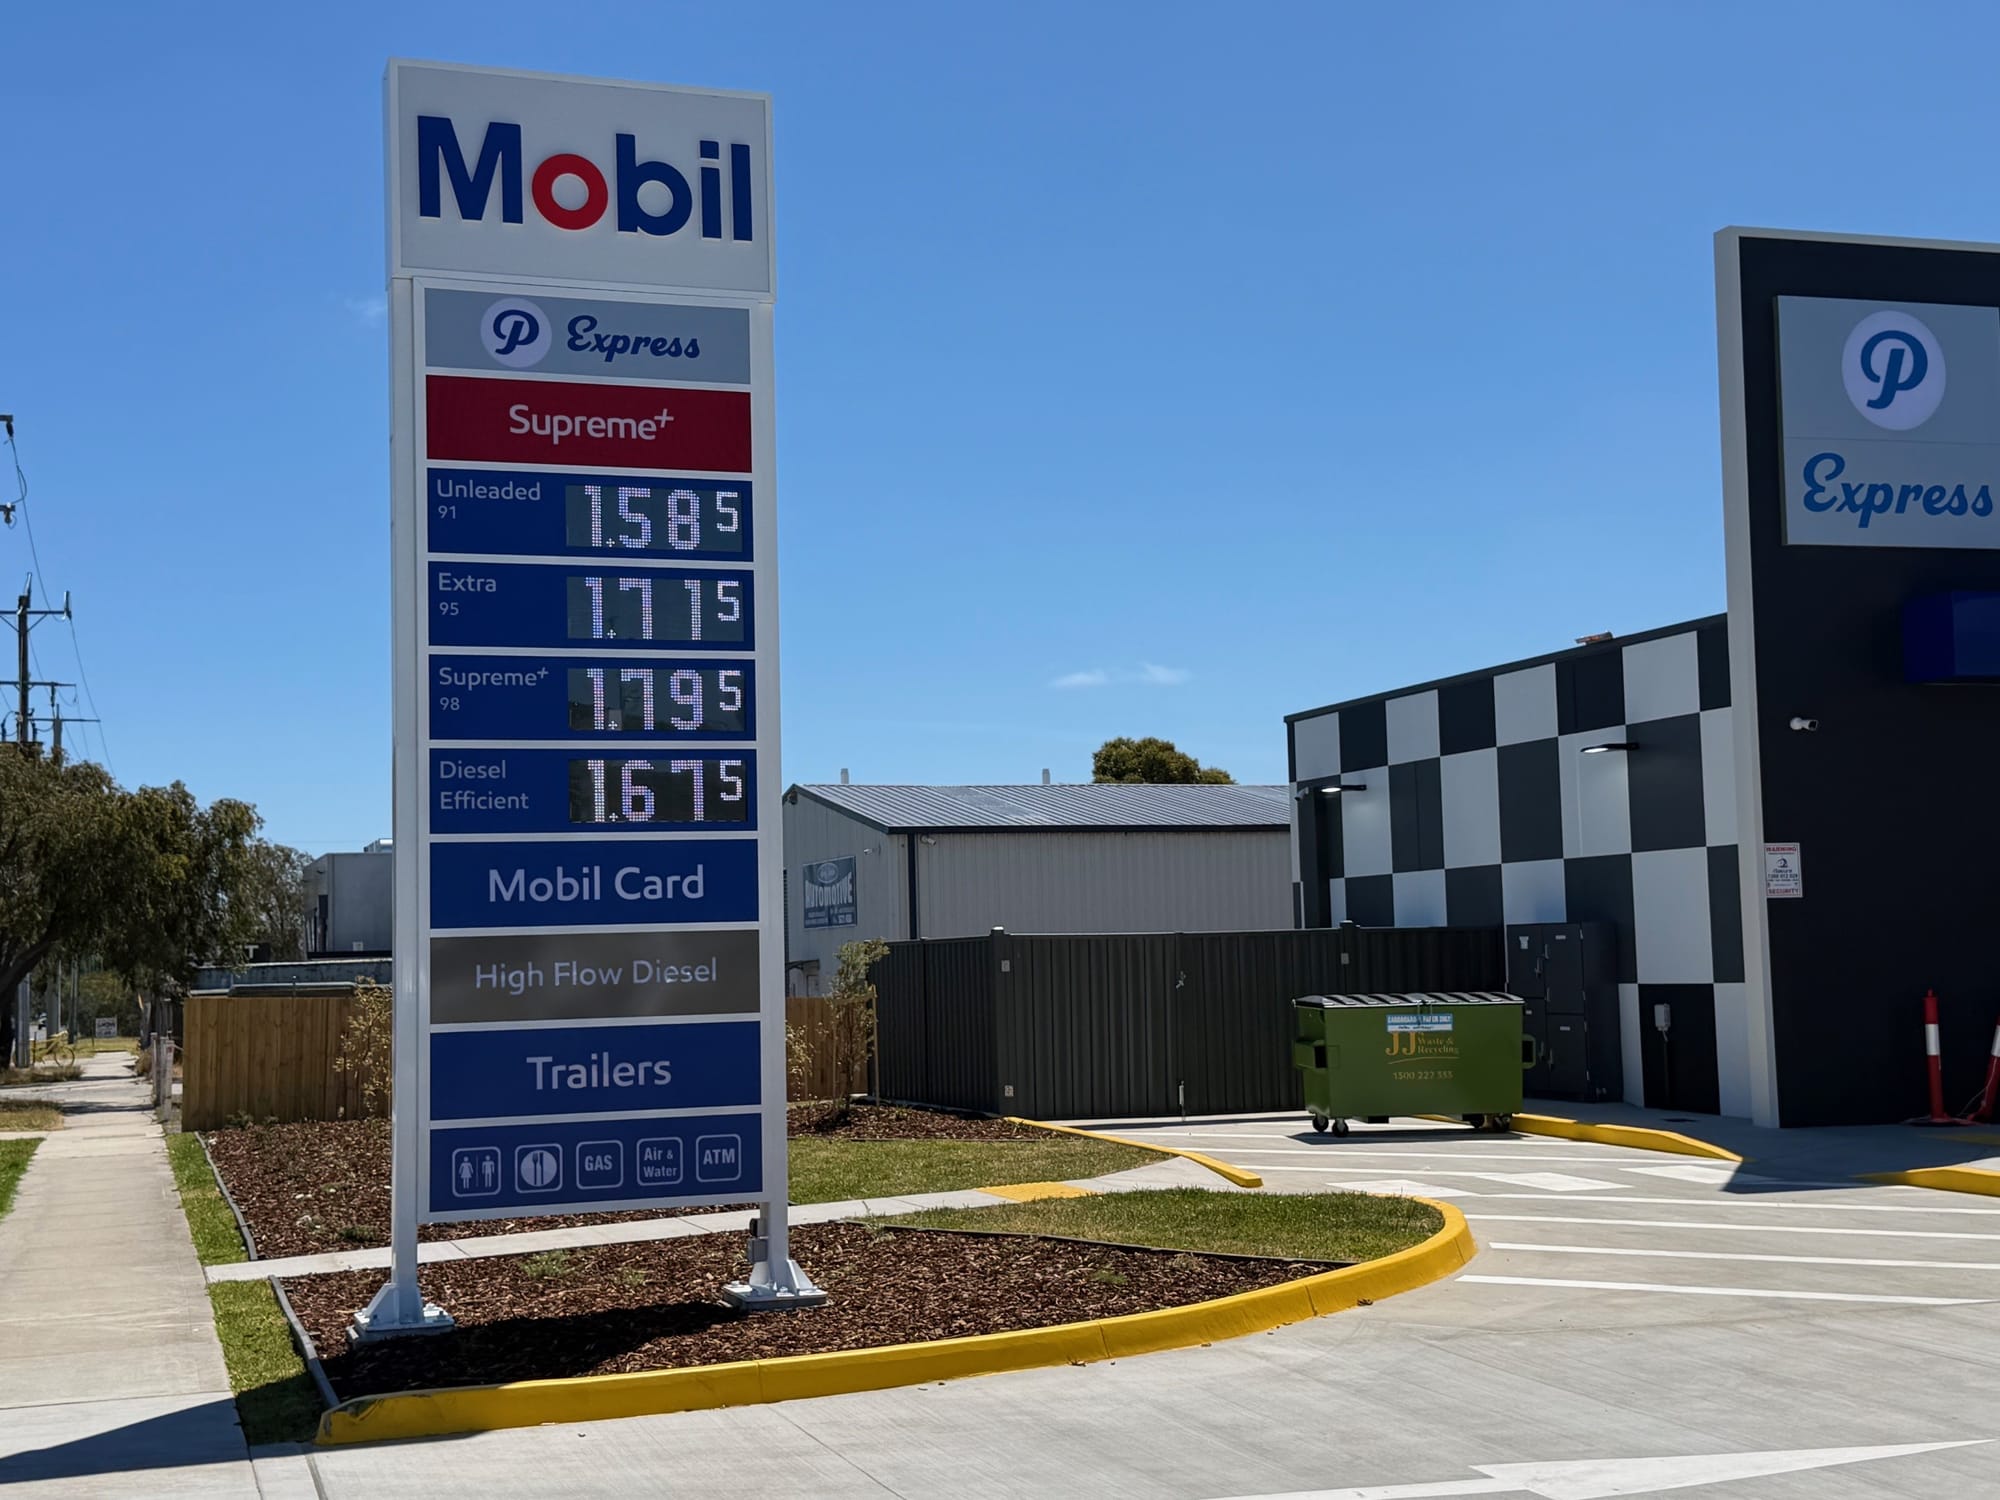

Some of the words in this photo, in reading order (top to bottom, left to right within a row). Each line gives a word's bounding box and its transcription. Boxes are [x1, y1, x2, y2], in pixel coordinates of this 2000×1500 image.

[417, 115, 752, 241] Mobil
[566, 314, 701, 362] Express
[436, 479, 541, 500] Unleaded
[1803, 452, 1993, 528] Express
[438, 505, 457, 519] 91
[438, 572, 497, 592] Extra
[439, 602, 459, 616] 95
[439, 697, 460, 711] 98
[439, 760, 507, 779] Diesel
[439, 791, 529, 810] Efficient
[488, 866, 600, 902] Mobil
[614, 864, 704, 900] Card
[476, 961, 544, 995] High
[554, 960, 623, 986] Flow
[633, 956, 717, 984] Diesel
[526, 1052, 672, 1090] Trailers
[584, 1154, 613, 1172] GAS
[643, 1147, 663, 1162] Air
[666, 1150, 674, 1160] &
[703, 1148, 736, 1166] ATM
[643, 1165, 678, 1179] Water
